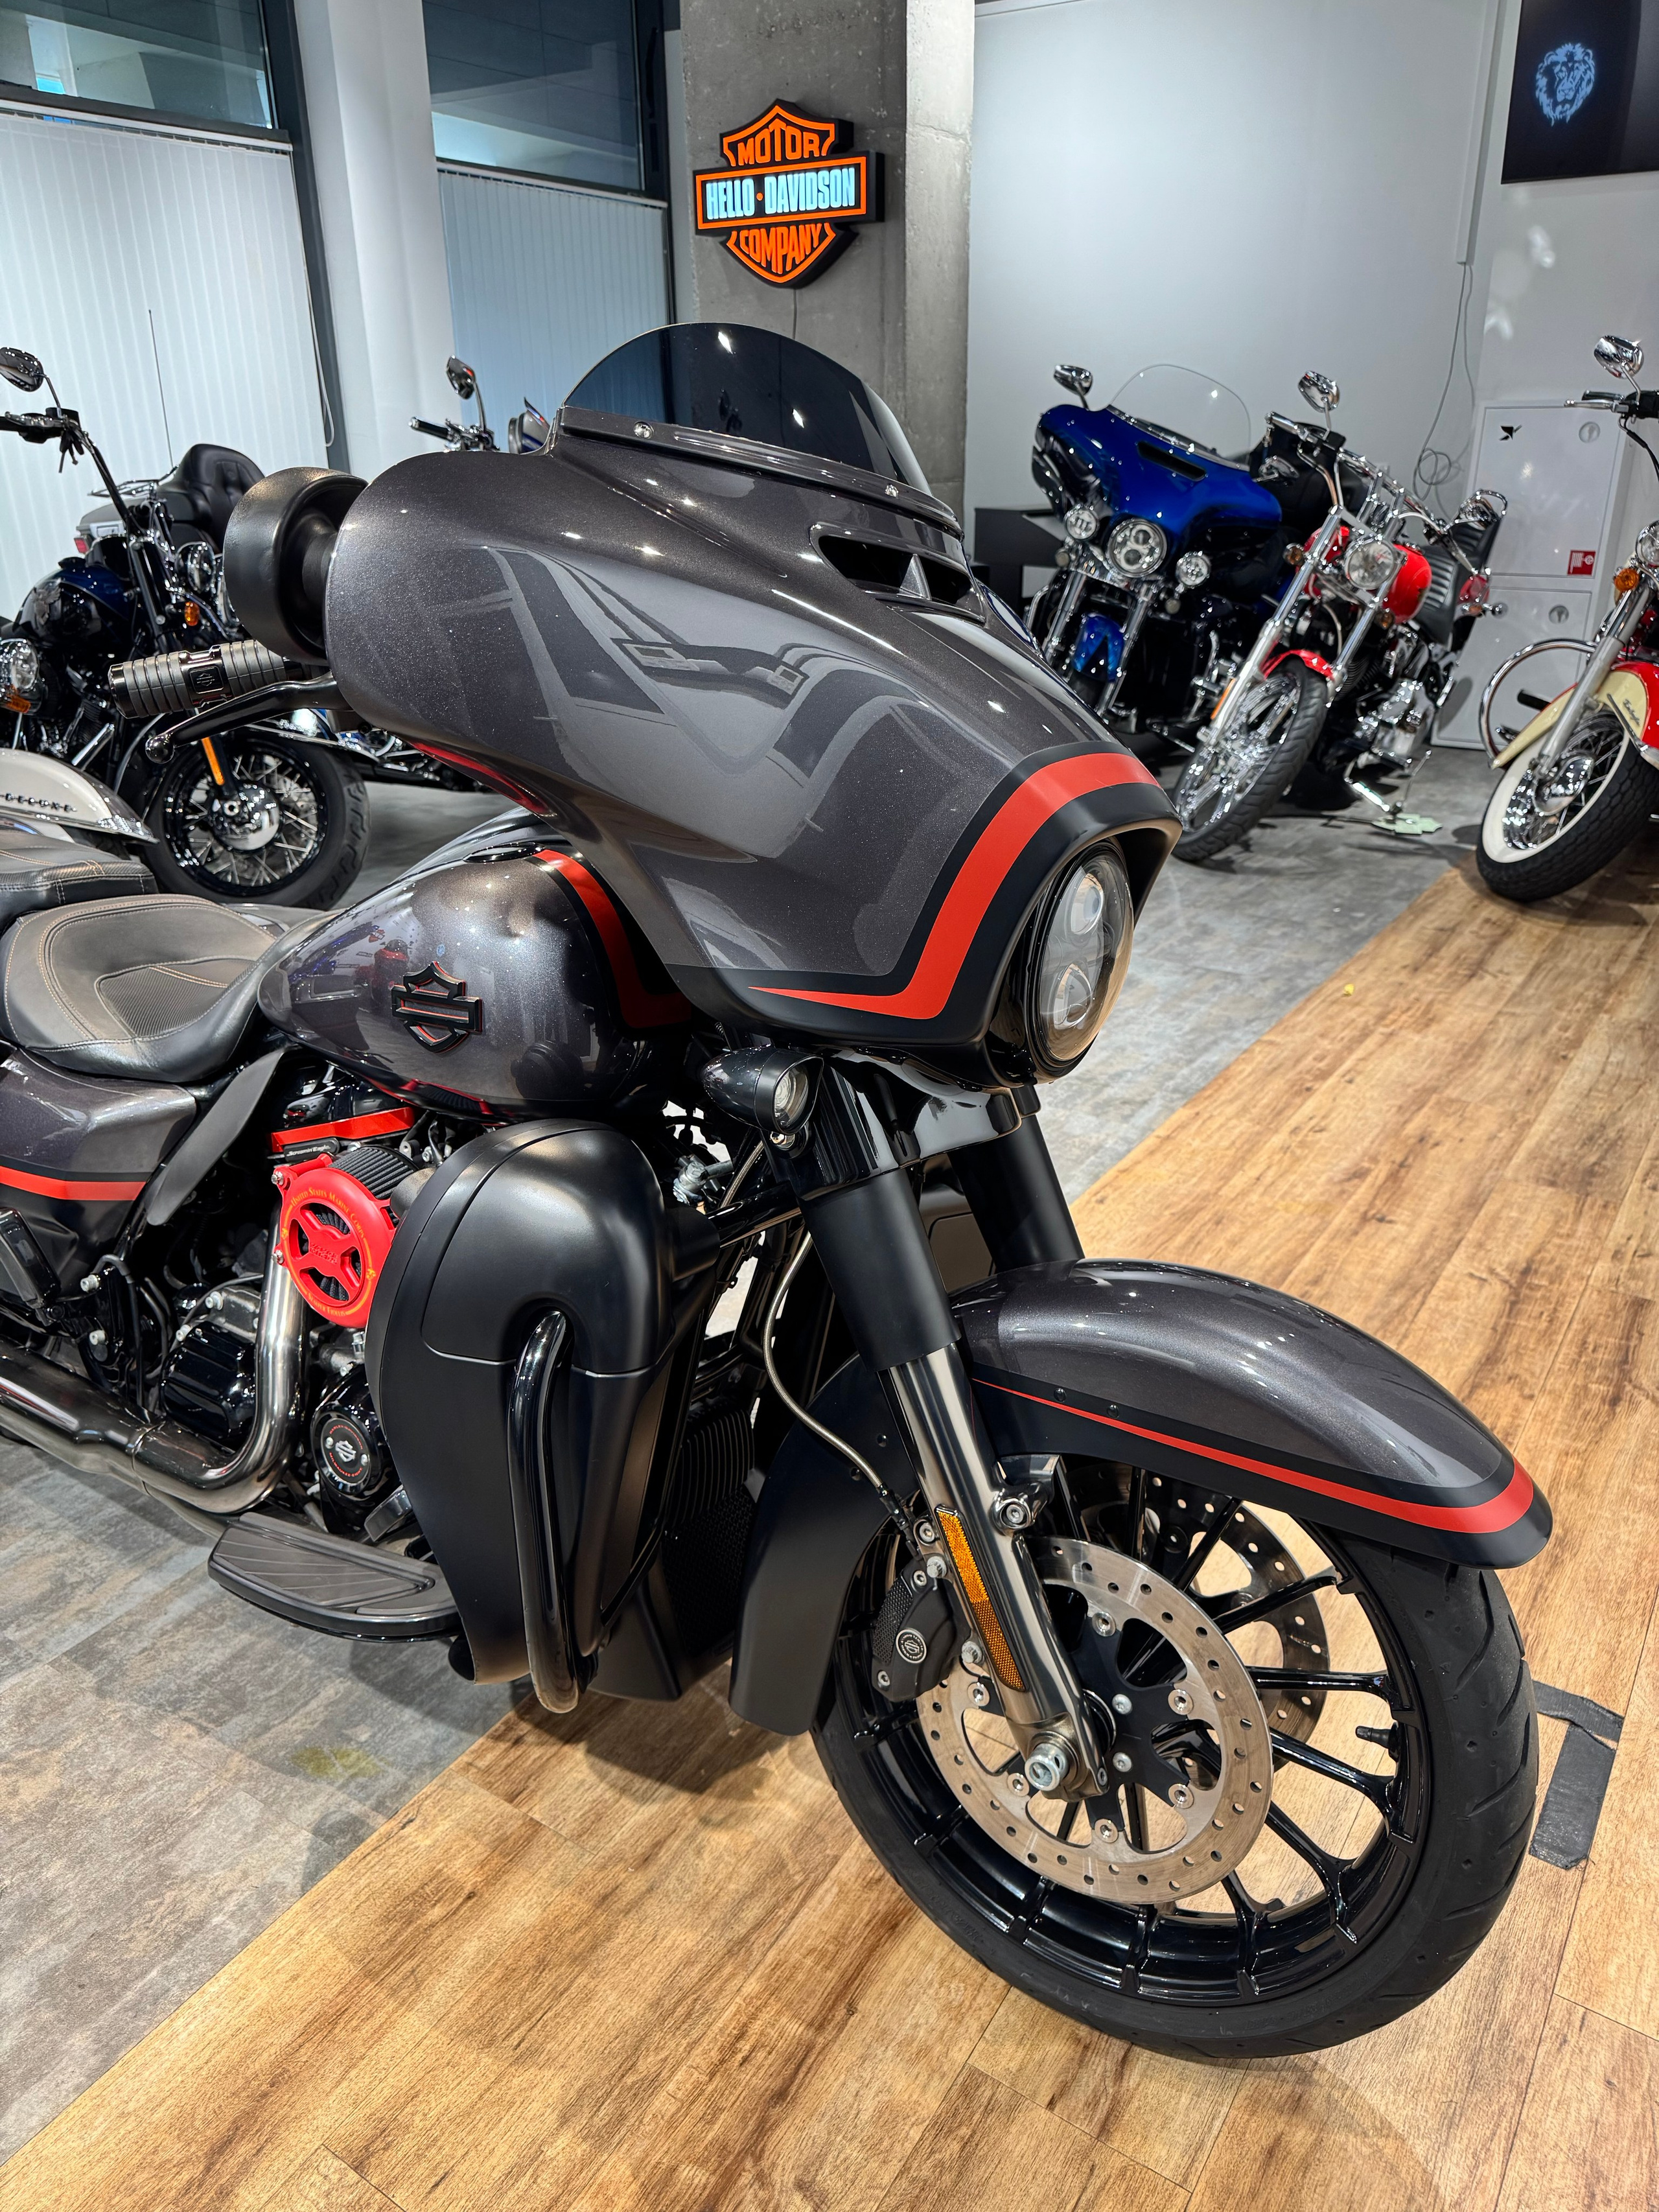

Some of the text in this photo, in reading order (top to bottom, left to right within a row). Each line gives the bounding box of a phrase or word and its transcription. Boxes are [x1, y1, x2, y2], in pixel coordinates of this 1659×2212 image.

[737, 118, 820, 166] MOTOR
[706, 167, 855, 220] HELLO DAVIDSON
[739, 223, 822, 274] COMPANY
